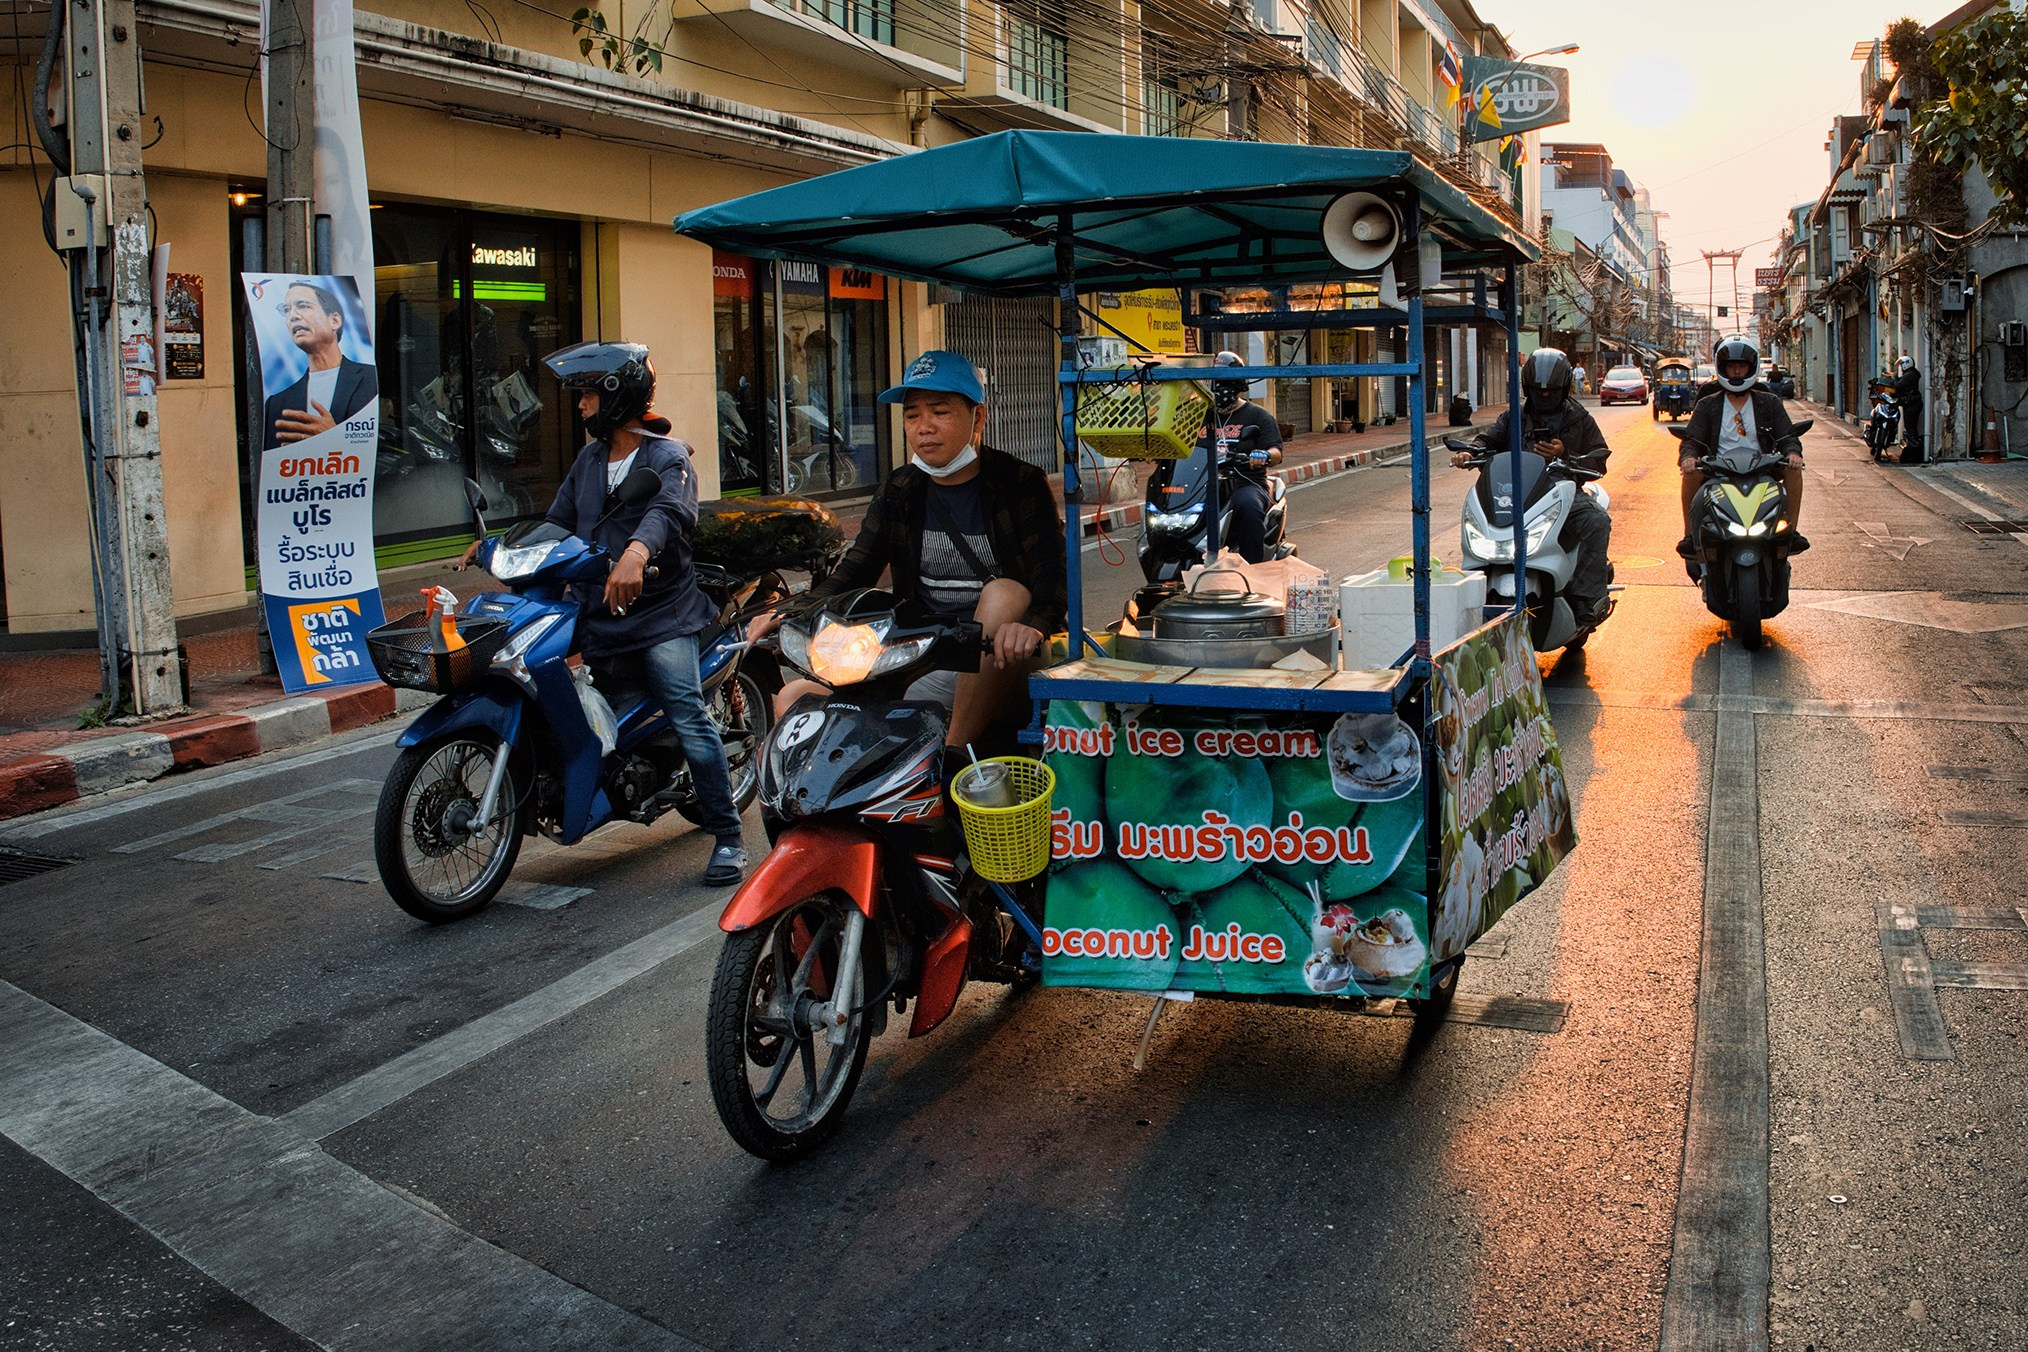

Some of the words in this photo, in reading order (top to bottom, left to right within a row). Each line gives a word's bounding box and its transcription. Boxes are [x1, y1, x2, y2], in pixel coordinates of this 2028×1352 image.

[713, 266, 746, 279] ONDA
[781, 261, 819, 283] YAMAHA
[841, 269, 872, 289] KTM
[346, 418, 375, 432] กรณ์
[279, 451, 360, 478] ยกเลิก
[266, 478, 368, 504] แบล็กลิสต์
[293, 504, 332, 535] บูโร
[278, 534, 355, 564] รื้อระบบ
[288, 560, 353, 591] สินเชื่อ
[301, 605, 349, 631] ชาติ
[306, 631, 353, 647] พัฒนา
[312, 645, 361, 672] กล้า
[827, 703, 862, 712] HONDA
[1127, 720, 1185, 757] ice
[1194, 727, 1322, 758] cream
[1119, 811, 1373, 863] มะพร้าวอ่อน
[1043, 925, 1172, 959] oconut
[1183, 923, 1285, 962] Juice
